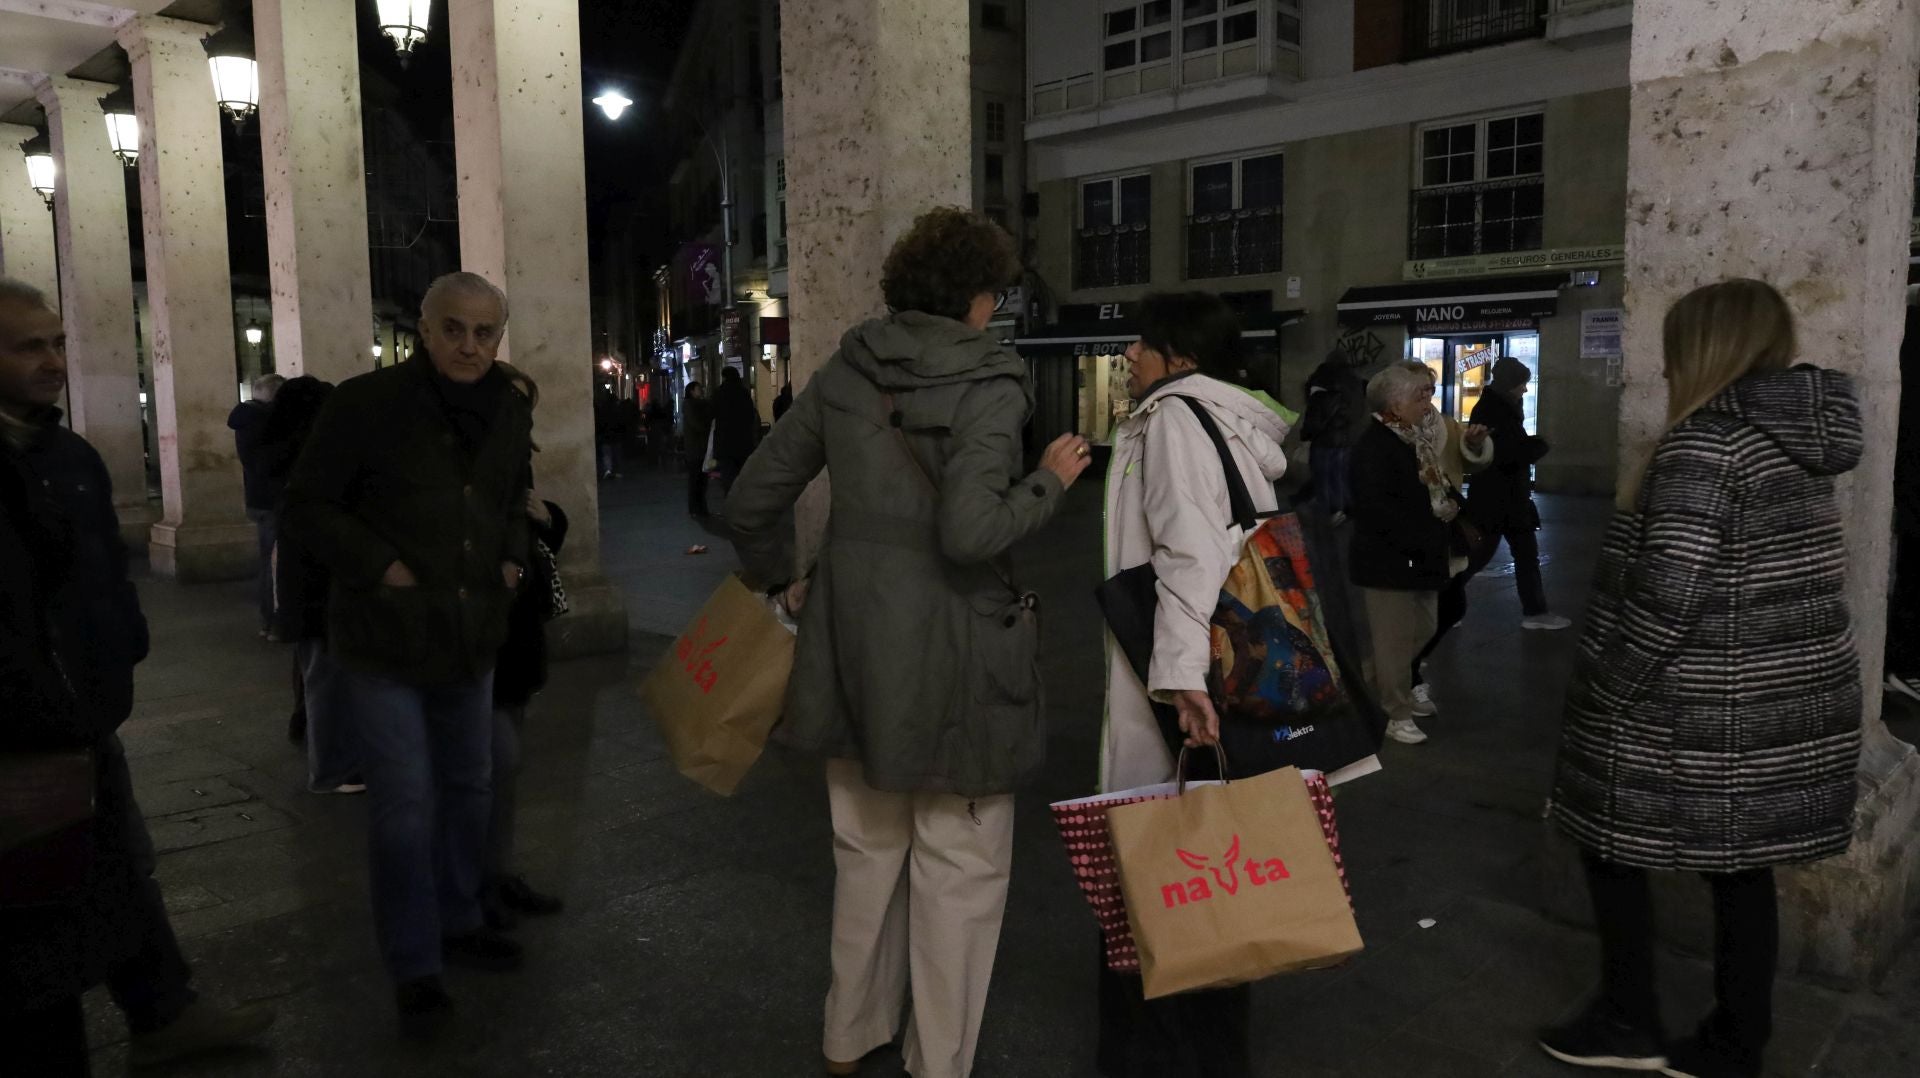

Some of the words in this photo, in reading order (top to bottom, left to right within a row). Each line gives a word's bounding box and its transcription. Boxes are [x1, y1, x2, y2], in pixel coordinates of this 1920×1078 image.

[1500, 254, 1546, 265] SEGUROS
[1551, 249, 1611, 261] GENERALES
[1099, 303, 1124, 320] EL
[1373, 313, 1401, 321] JOYERIA
[1416, 306, 1465, 321] NANO
[1074, 344, 1089, 355] EL
